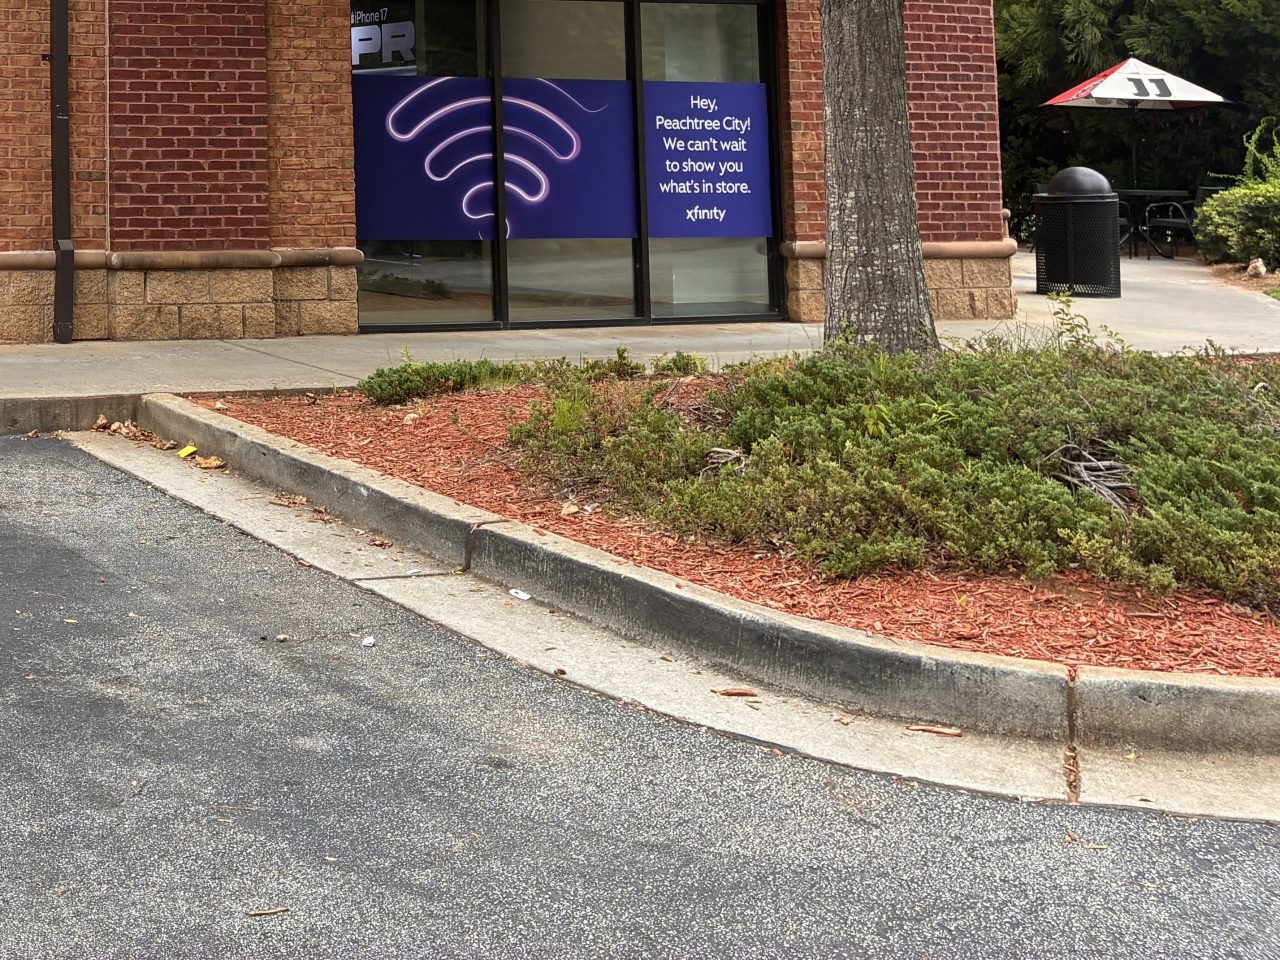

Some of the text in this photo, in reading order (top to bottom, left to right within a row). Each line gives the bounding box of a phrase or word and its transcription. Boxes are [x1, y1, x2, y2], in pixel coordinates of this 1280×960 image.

[353, 7, 388, 24] iPhone 17
[1126, 77, 1173, 97] JJ
[690, 95, 718, 112] Hey,
[655, 116, 751, 134] Peachtree City!
[662, 137, 747, 152] We can't wait
[665, 158, 743, 176] to show you
[659, 179, 751, 194] what's in store.
[686, 205, 726, 222] xfinity
